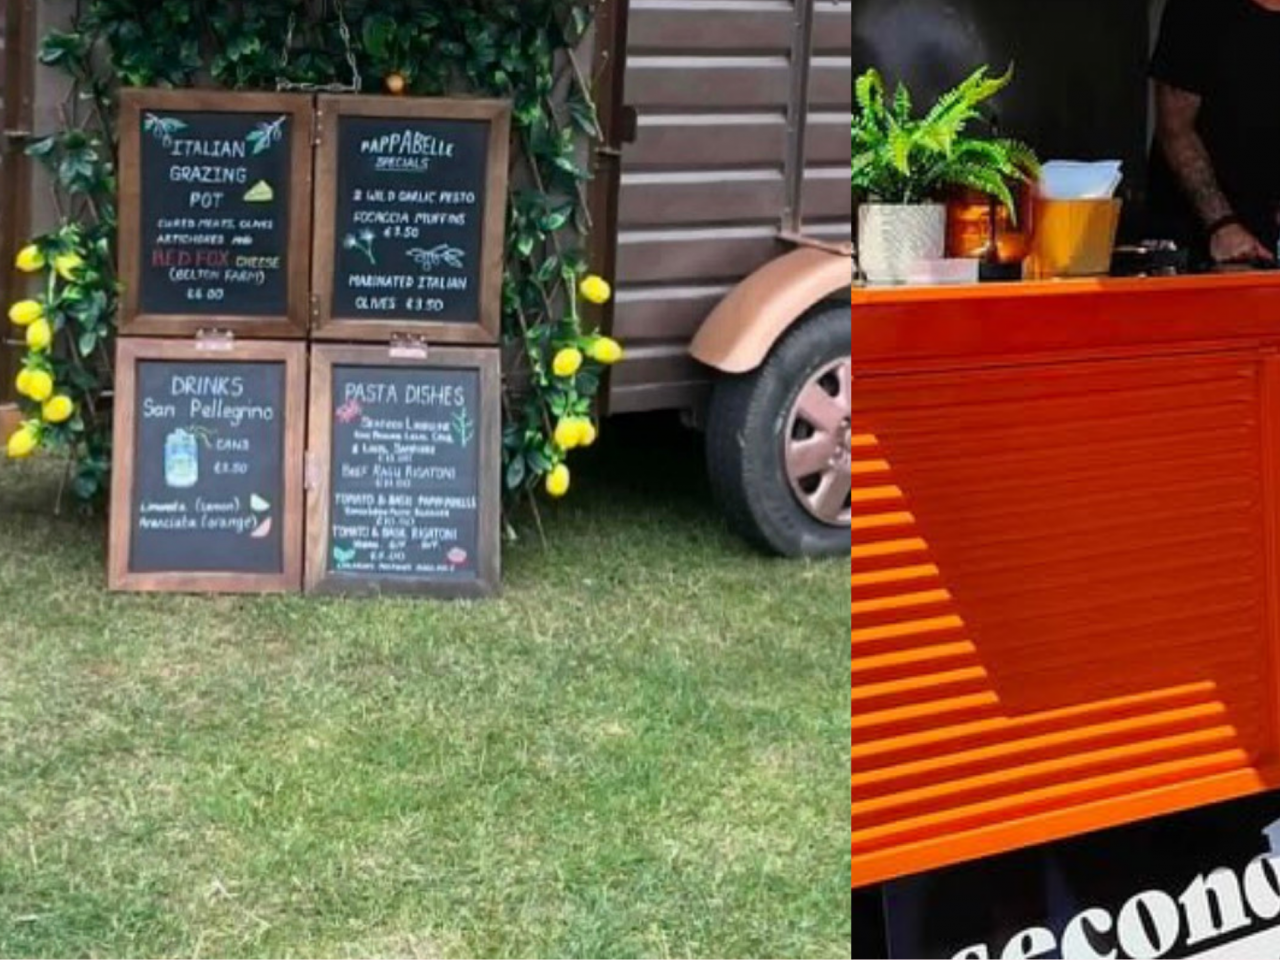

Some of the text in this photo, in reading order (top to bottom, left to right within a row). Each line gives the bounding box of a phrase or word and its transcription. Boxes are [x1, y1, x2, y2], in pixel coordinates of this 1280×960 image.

[170, 141, 246, 157] ITALIAN
[361, 129, 456, 157] PAPPABELLE
[375, 156, 430, 169] SPECIALS
[169, 165, 247, 183] GRAZING
[190, 192, 224, 208] POT
[366, 190, 396, 202] WILD
[398, 192, 434, 203] GARLIC
[439, 192, 475, 204] PESTO
[353, 211, 466, 225] FOCACCIA MUFFINS
[195, 249, 230, 266] FOX
[235, 255, 281, 268] CHEESE
[348, 273, 468, 290] MARINATED ITALIAN
[355, 296, 396, 309] OLIVES
[171, 375, 244, 395] DRINKS
[344, 382, 465, 406] PASTA DISHES
[143, 397, 274, 427] San Pellegrino
[215, 438, 250, 451] CANS
[404, 464, 456, 480] RIGATONI
[335, 492, 375, 506] TOMATO
[332, 524, 370, 537] TOMATO
[411, 527, 458, 540] RIGATONI
